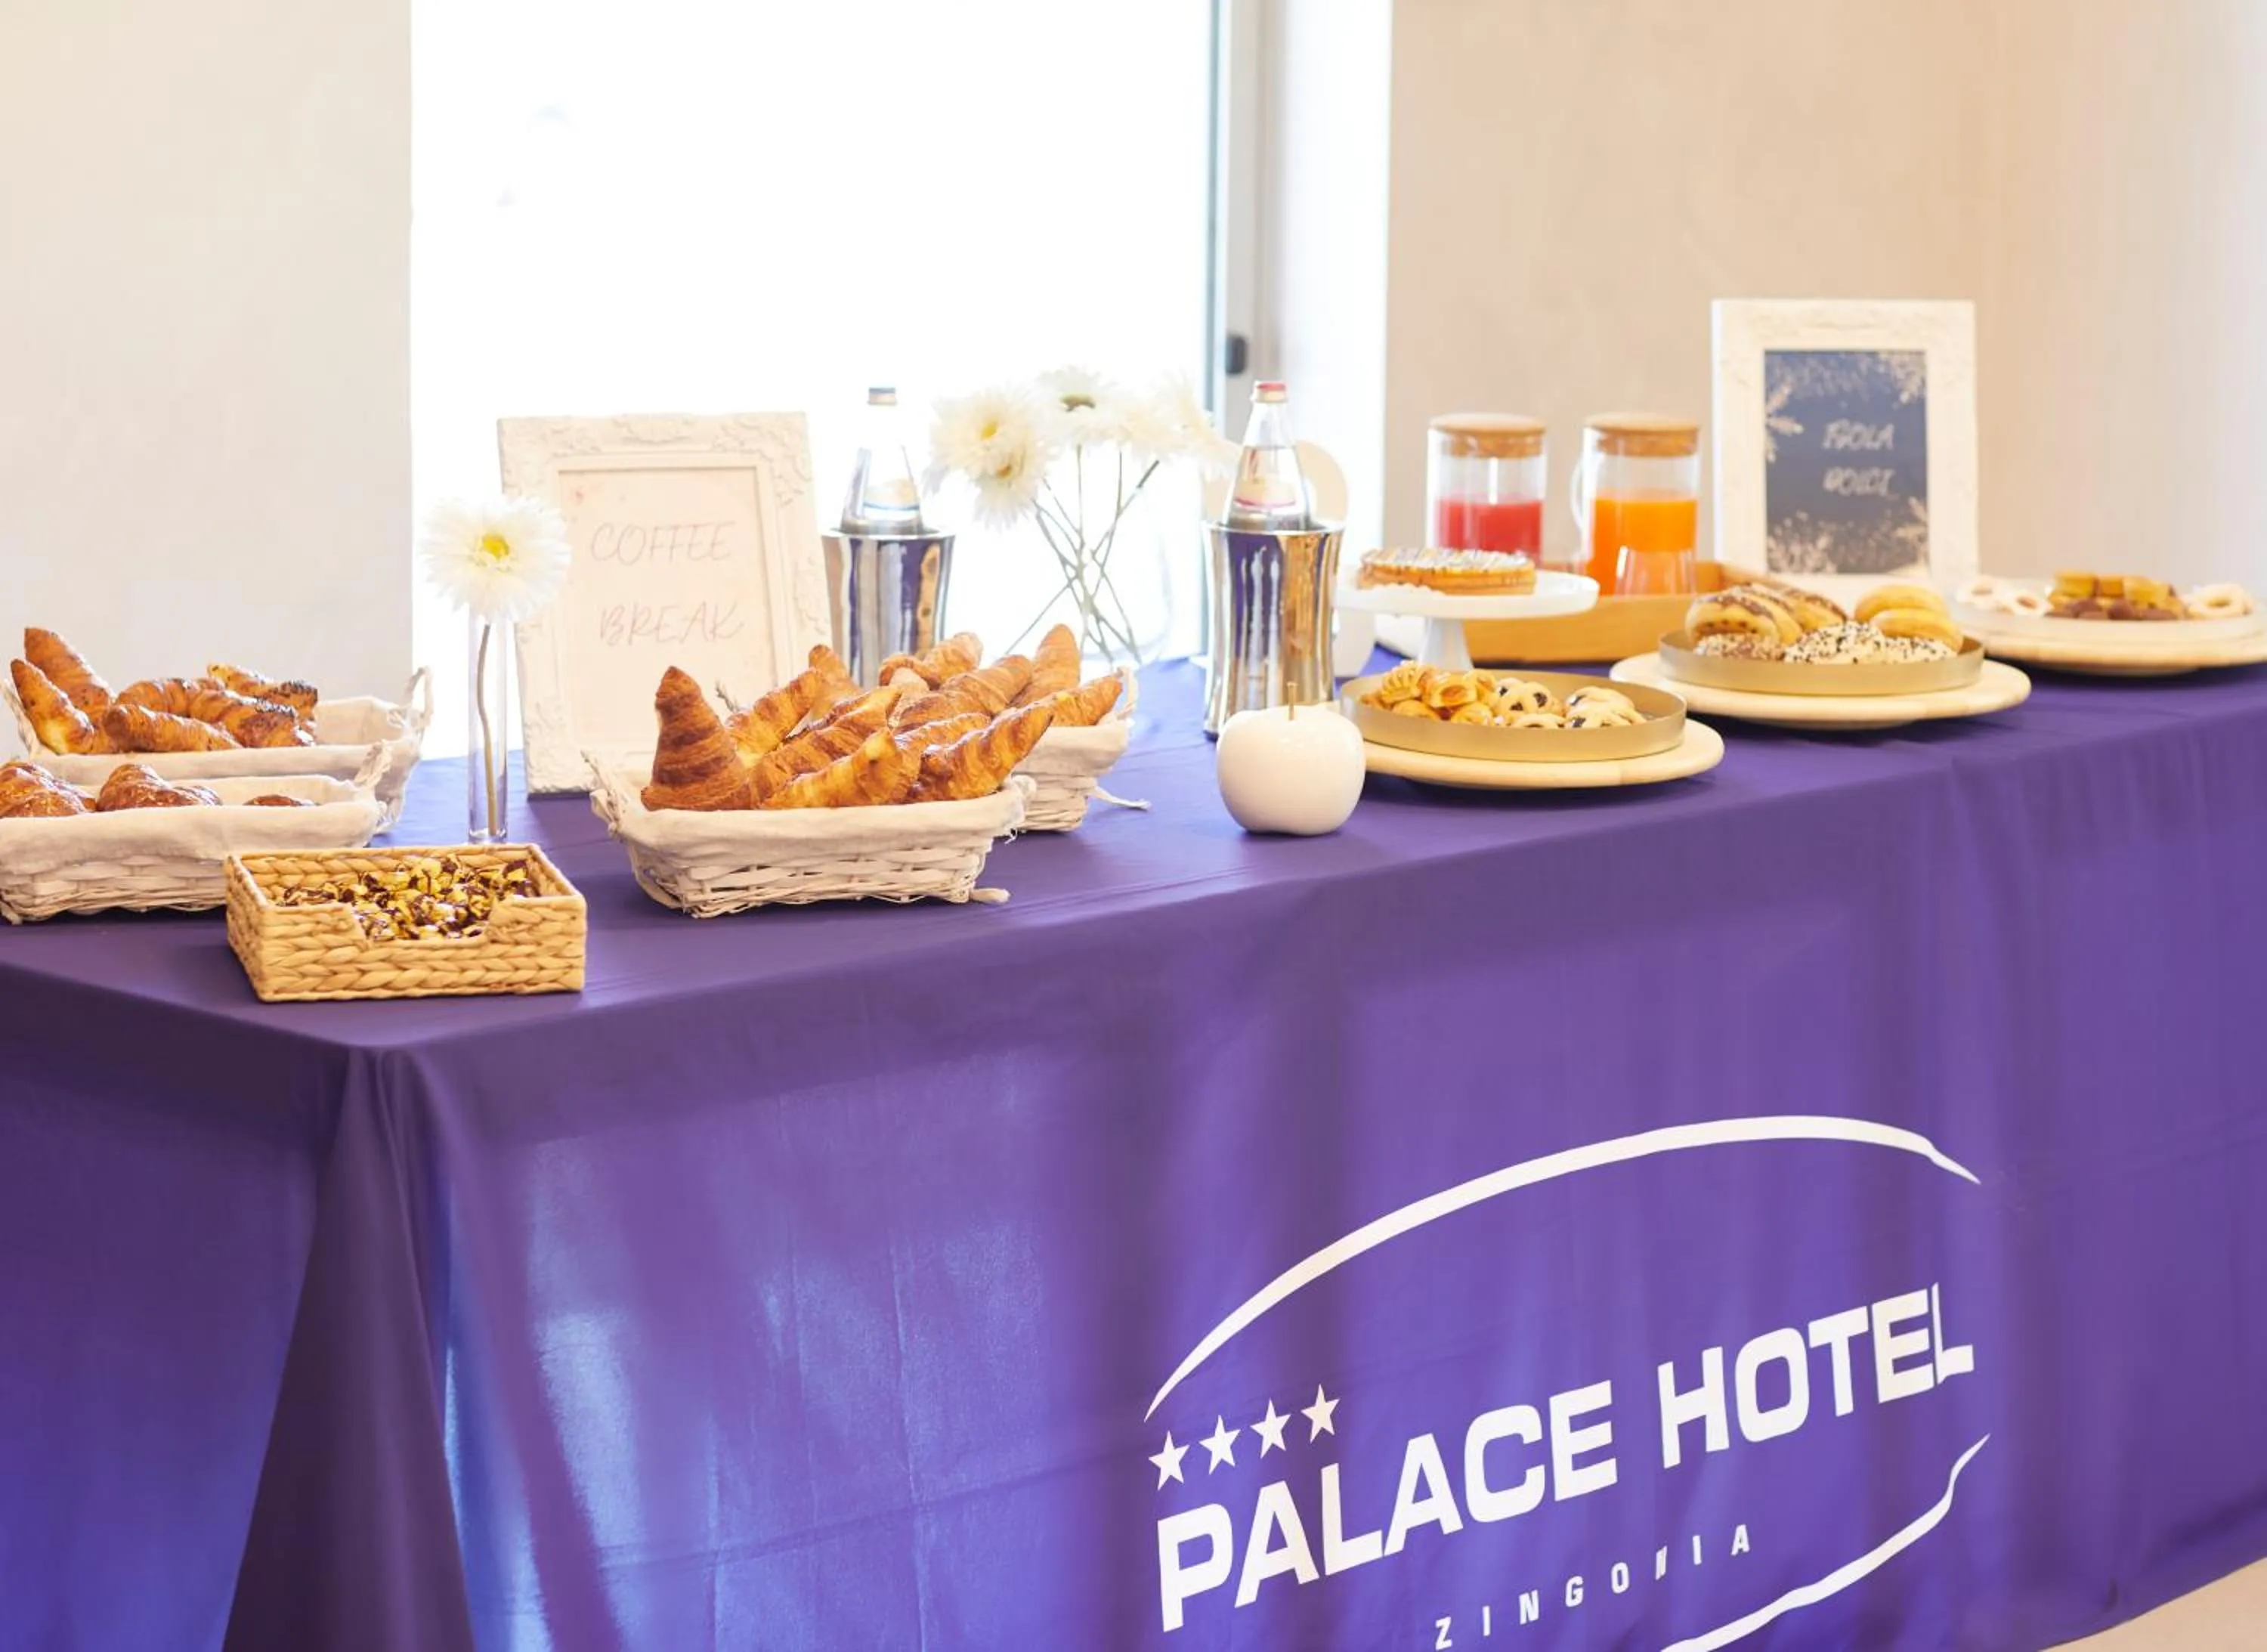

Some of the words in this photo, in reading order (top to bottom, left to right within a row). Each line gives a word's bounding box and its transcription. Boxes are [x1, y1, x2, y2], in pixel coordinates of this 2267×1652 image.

[590, 520, 737, 567] COFFEE
[599, 599, 745, 647] BREAK
[1156, 1379, 1618, 1633] PALACE
[1657, 1282, 1975, 1469] HOTEL
